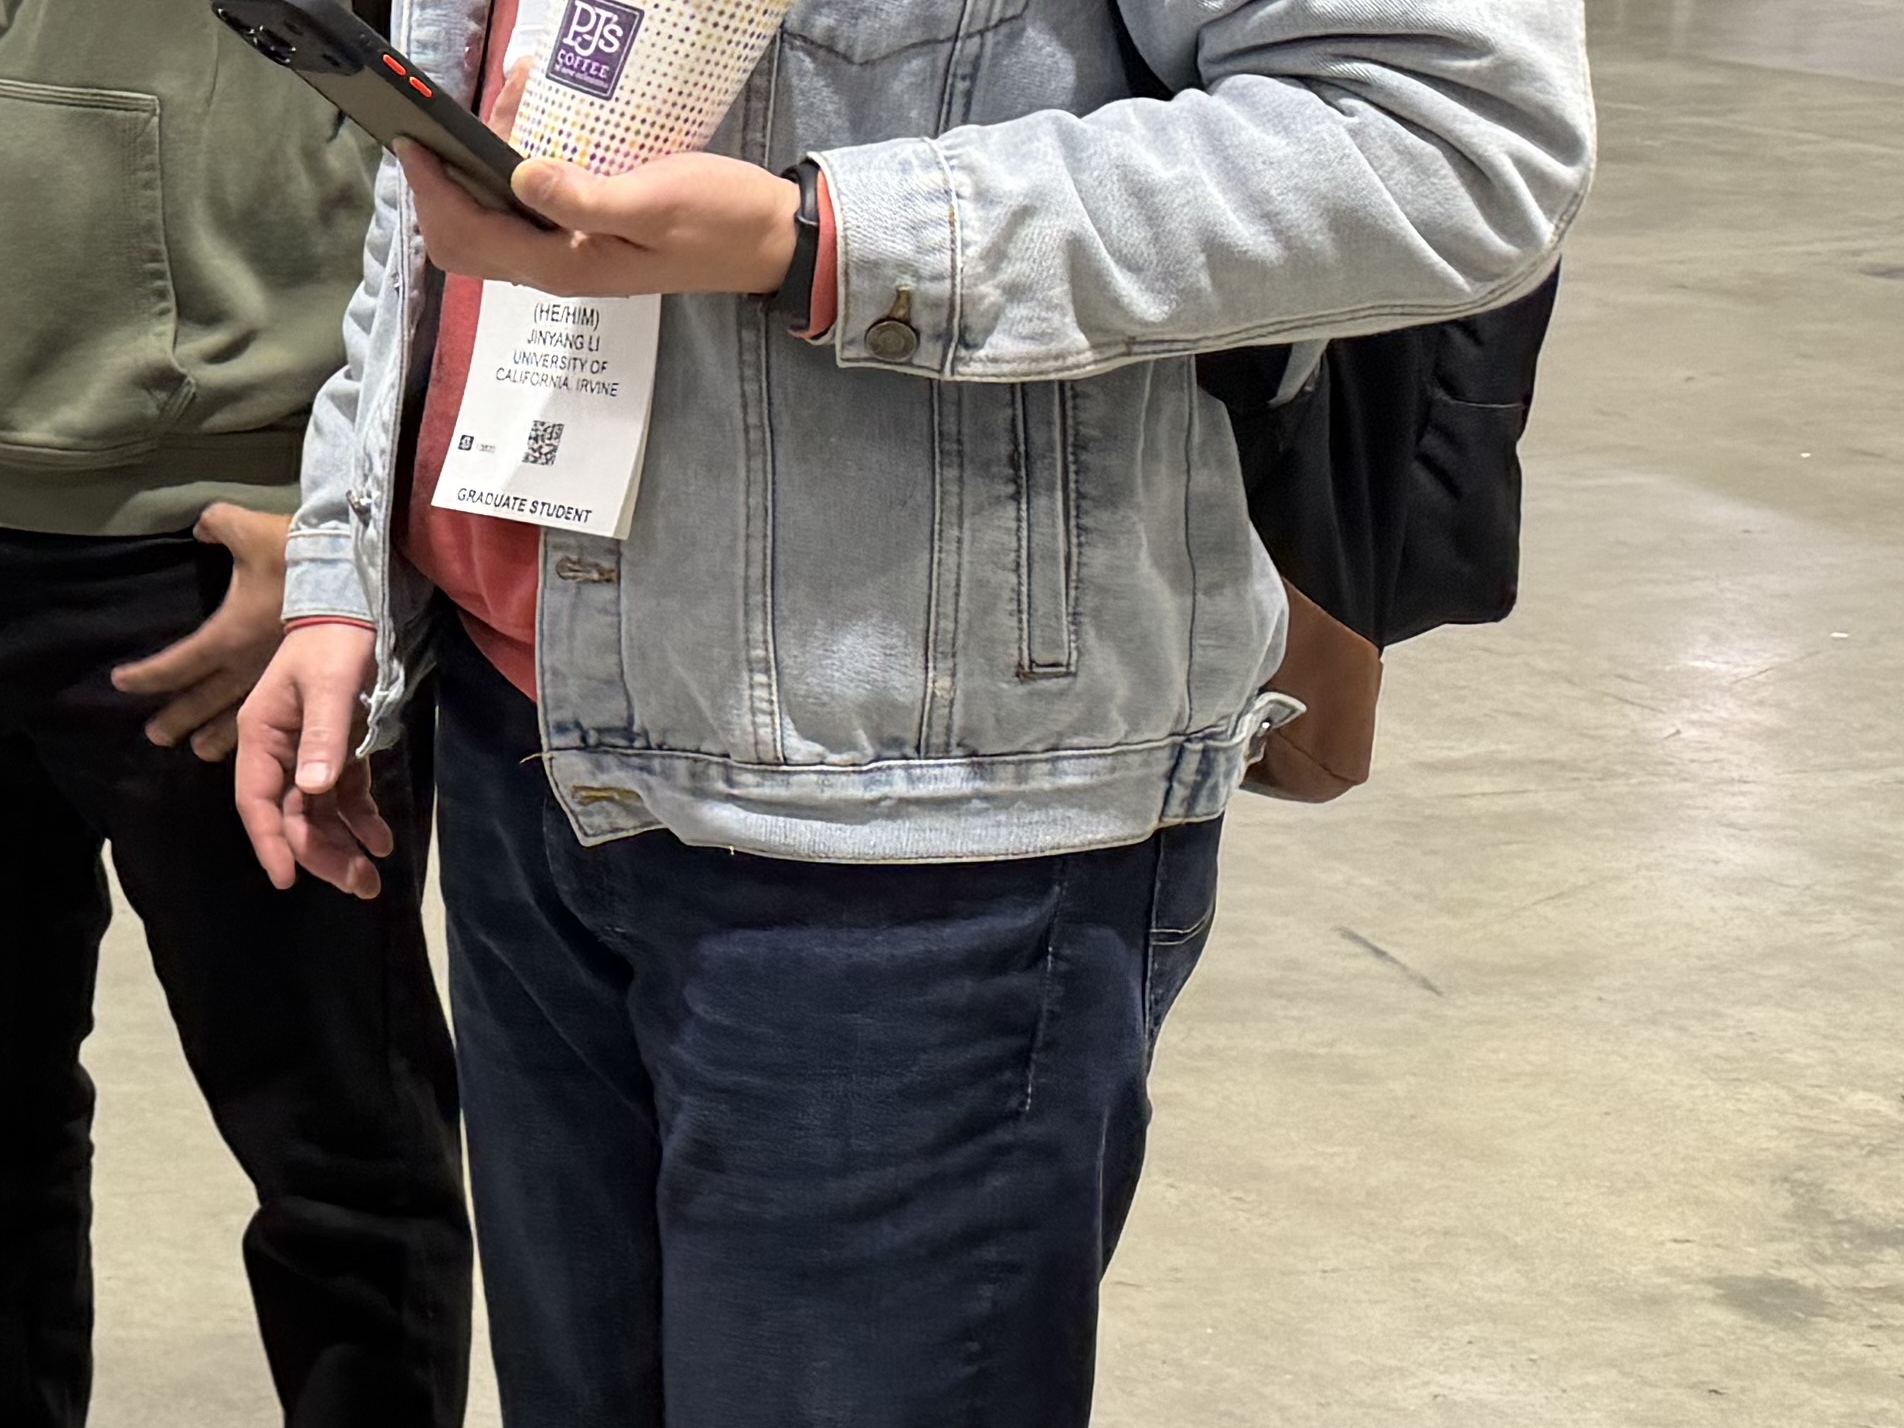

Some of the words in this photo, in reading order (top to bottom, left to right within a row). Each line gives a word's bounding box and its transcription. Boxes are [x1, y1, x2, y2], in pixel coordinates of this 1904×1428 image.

[563, 0, 624, 57] PJ's
[558, 49, 610, 78] COFFEE
[533, 303, 600, 330] (HE/HIM)
[527, 330, 585, 351] JINYANG
[588, 336, 600, 352] LI
[512, 350, 588, 372] UNIVERSITY
[591, 360, 608, 373] OF
[576, 378, 620, 397] IRVINE
[457, 487, 528, 513] GRADUATE
[529, 501, 593, 523] STUDENT
